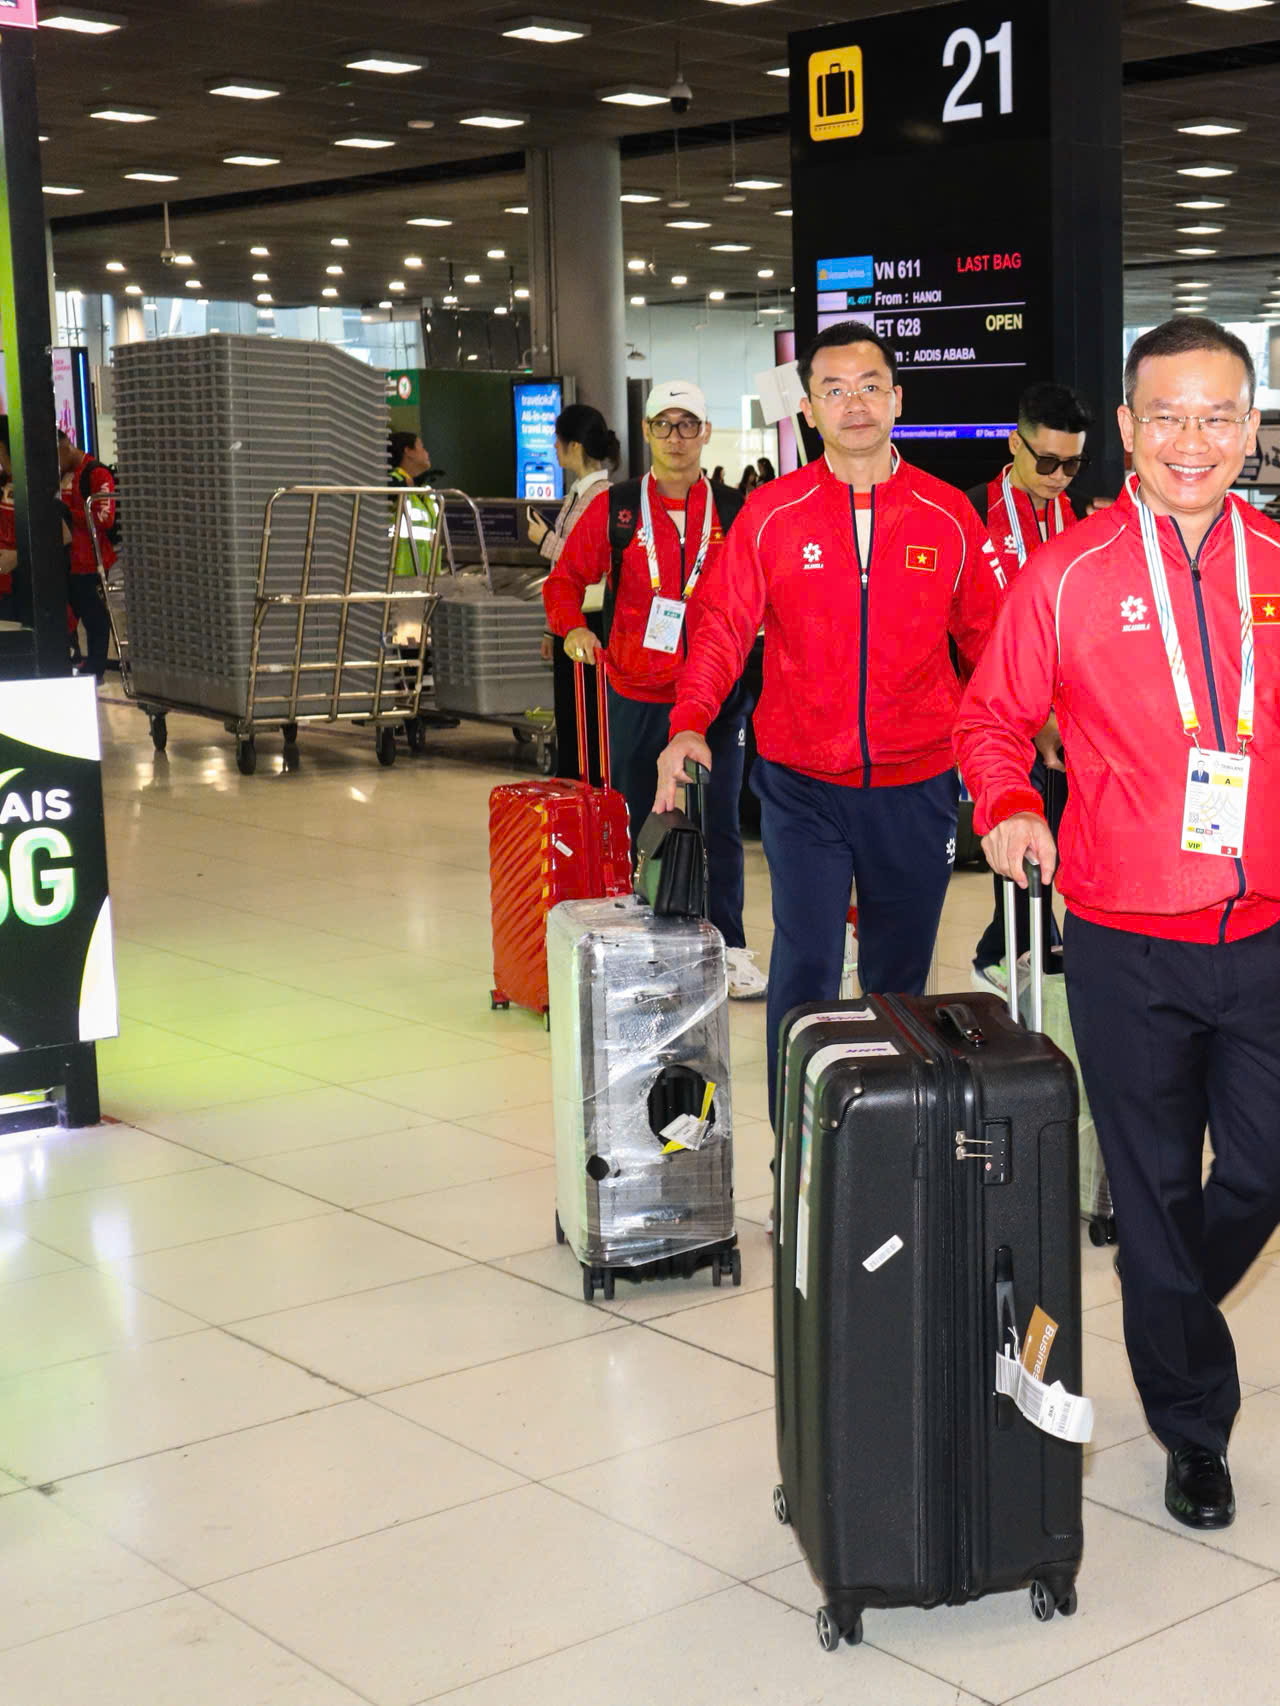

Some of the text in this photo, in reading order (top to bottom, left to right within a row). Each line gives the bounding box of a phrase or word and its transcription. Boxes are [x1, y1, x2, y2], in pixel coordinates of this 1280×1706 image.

[942, 20, 1013, 123] 21
[874, 261, 894, 280] VN
[897, 259, 920, 279] 611
[956, 252, 1022, 273] LAST BAG
[874, 291, 902, 306] From
[912, 290, 942, 303] HANOI
[875, 318, 921, 337] ET 628
[985, 314, 1022, 331] OPEN
[913, 348, 941, 362] ADDIS
[942, 347, 976, 360] ABABA
[0, 788, 72, 824] AIS
[1188, 842, 1201, 850] VIP
[0, 827, 76, 927] G
[1032, 1324, 1055, 1381] Busines
